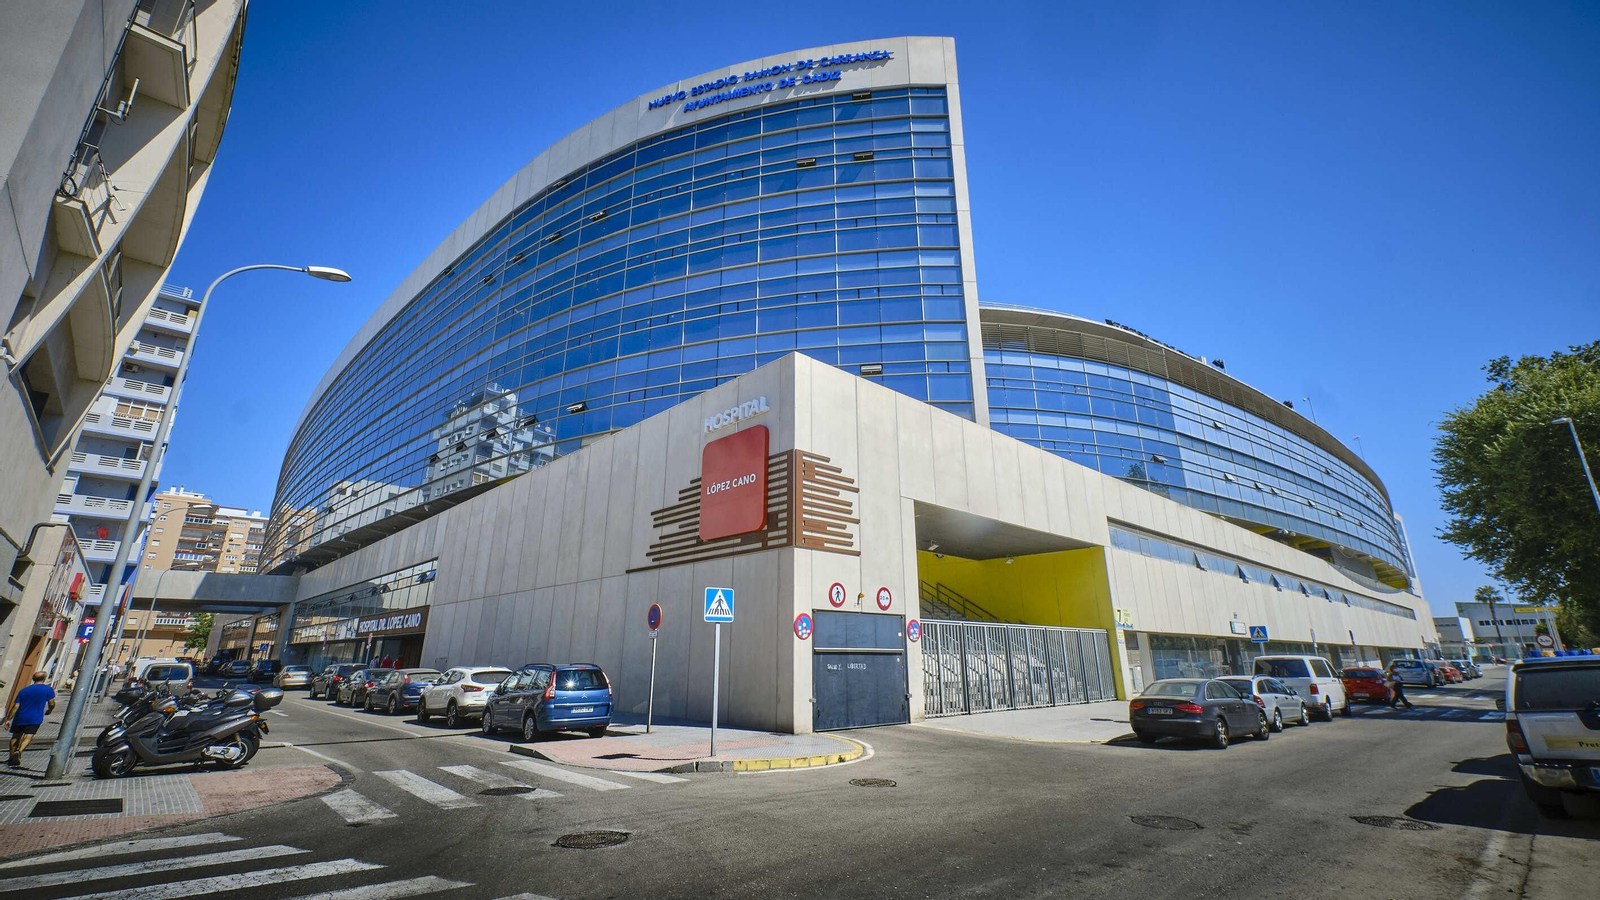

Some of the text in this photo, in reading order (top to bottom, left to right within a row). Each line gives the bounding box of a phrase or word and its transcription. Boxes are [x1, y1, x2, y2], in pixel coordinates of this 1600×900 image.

[648, 50, 891, 111] NUEVO ESTADIO RAMON DE CARRANZA
[683, 70, 842, 113] AYUNTAMIENTO DE CADIZ
[704, 396, 771, 433] HOSPITAL
[706, 473, 756, 495] LÓPEZ CANO
[359, 619, 379, 633] HOSPITAL
[404, 612, 421, 628] CANO
[1116, 609, 1122, 622] 7
[84, 626, 94, 636] P
